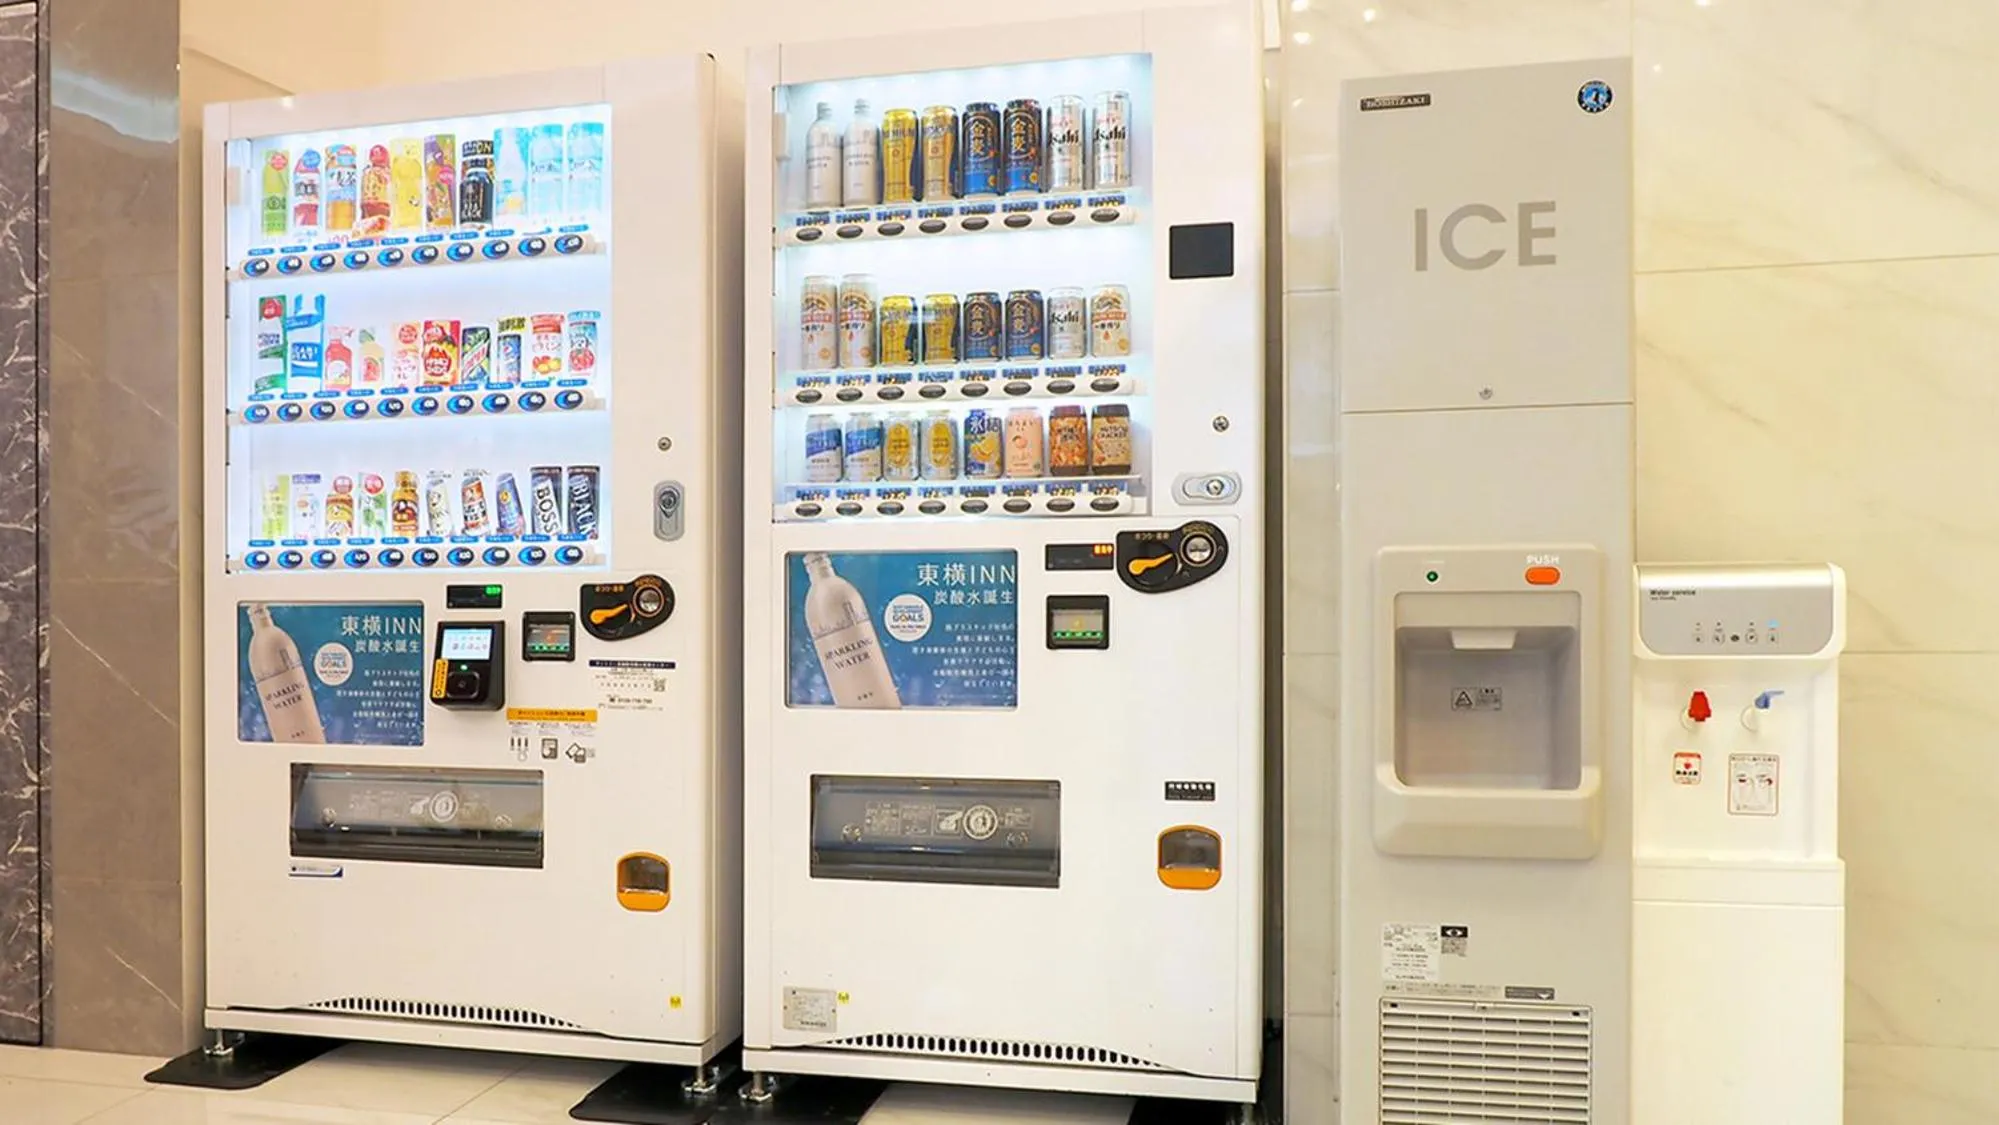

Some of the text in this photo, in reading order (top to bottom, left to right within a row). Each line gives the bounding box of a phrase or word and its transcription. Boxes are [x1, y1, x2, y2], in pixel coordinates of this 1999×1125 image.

[1414, 200, 1557, 272] ICE
[536, 485, 560, 533] BOSS
[1525, 555, 1560, 565] PUSH
[916, 563, 1016, 587] 東横INN
[934, 588, 1015, 606] 炭酸水誕生
[341, 614, 422, 637] 東横INN
[892, 612, 925, 623] GOALS
[825, 638, 874, 661] SPARKLING
[833, 651, 871, 671] WATER
